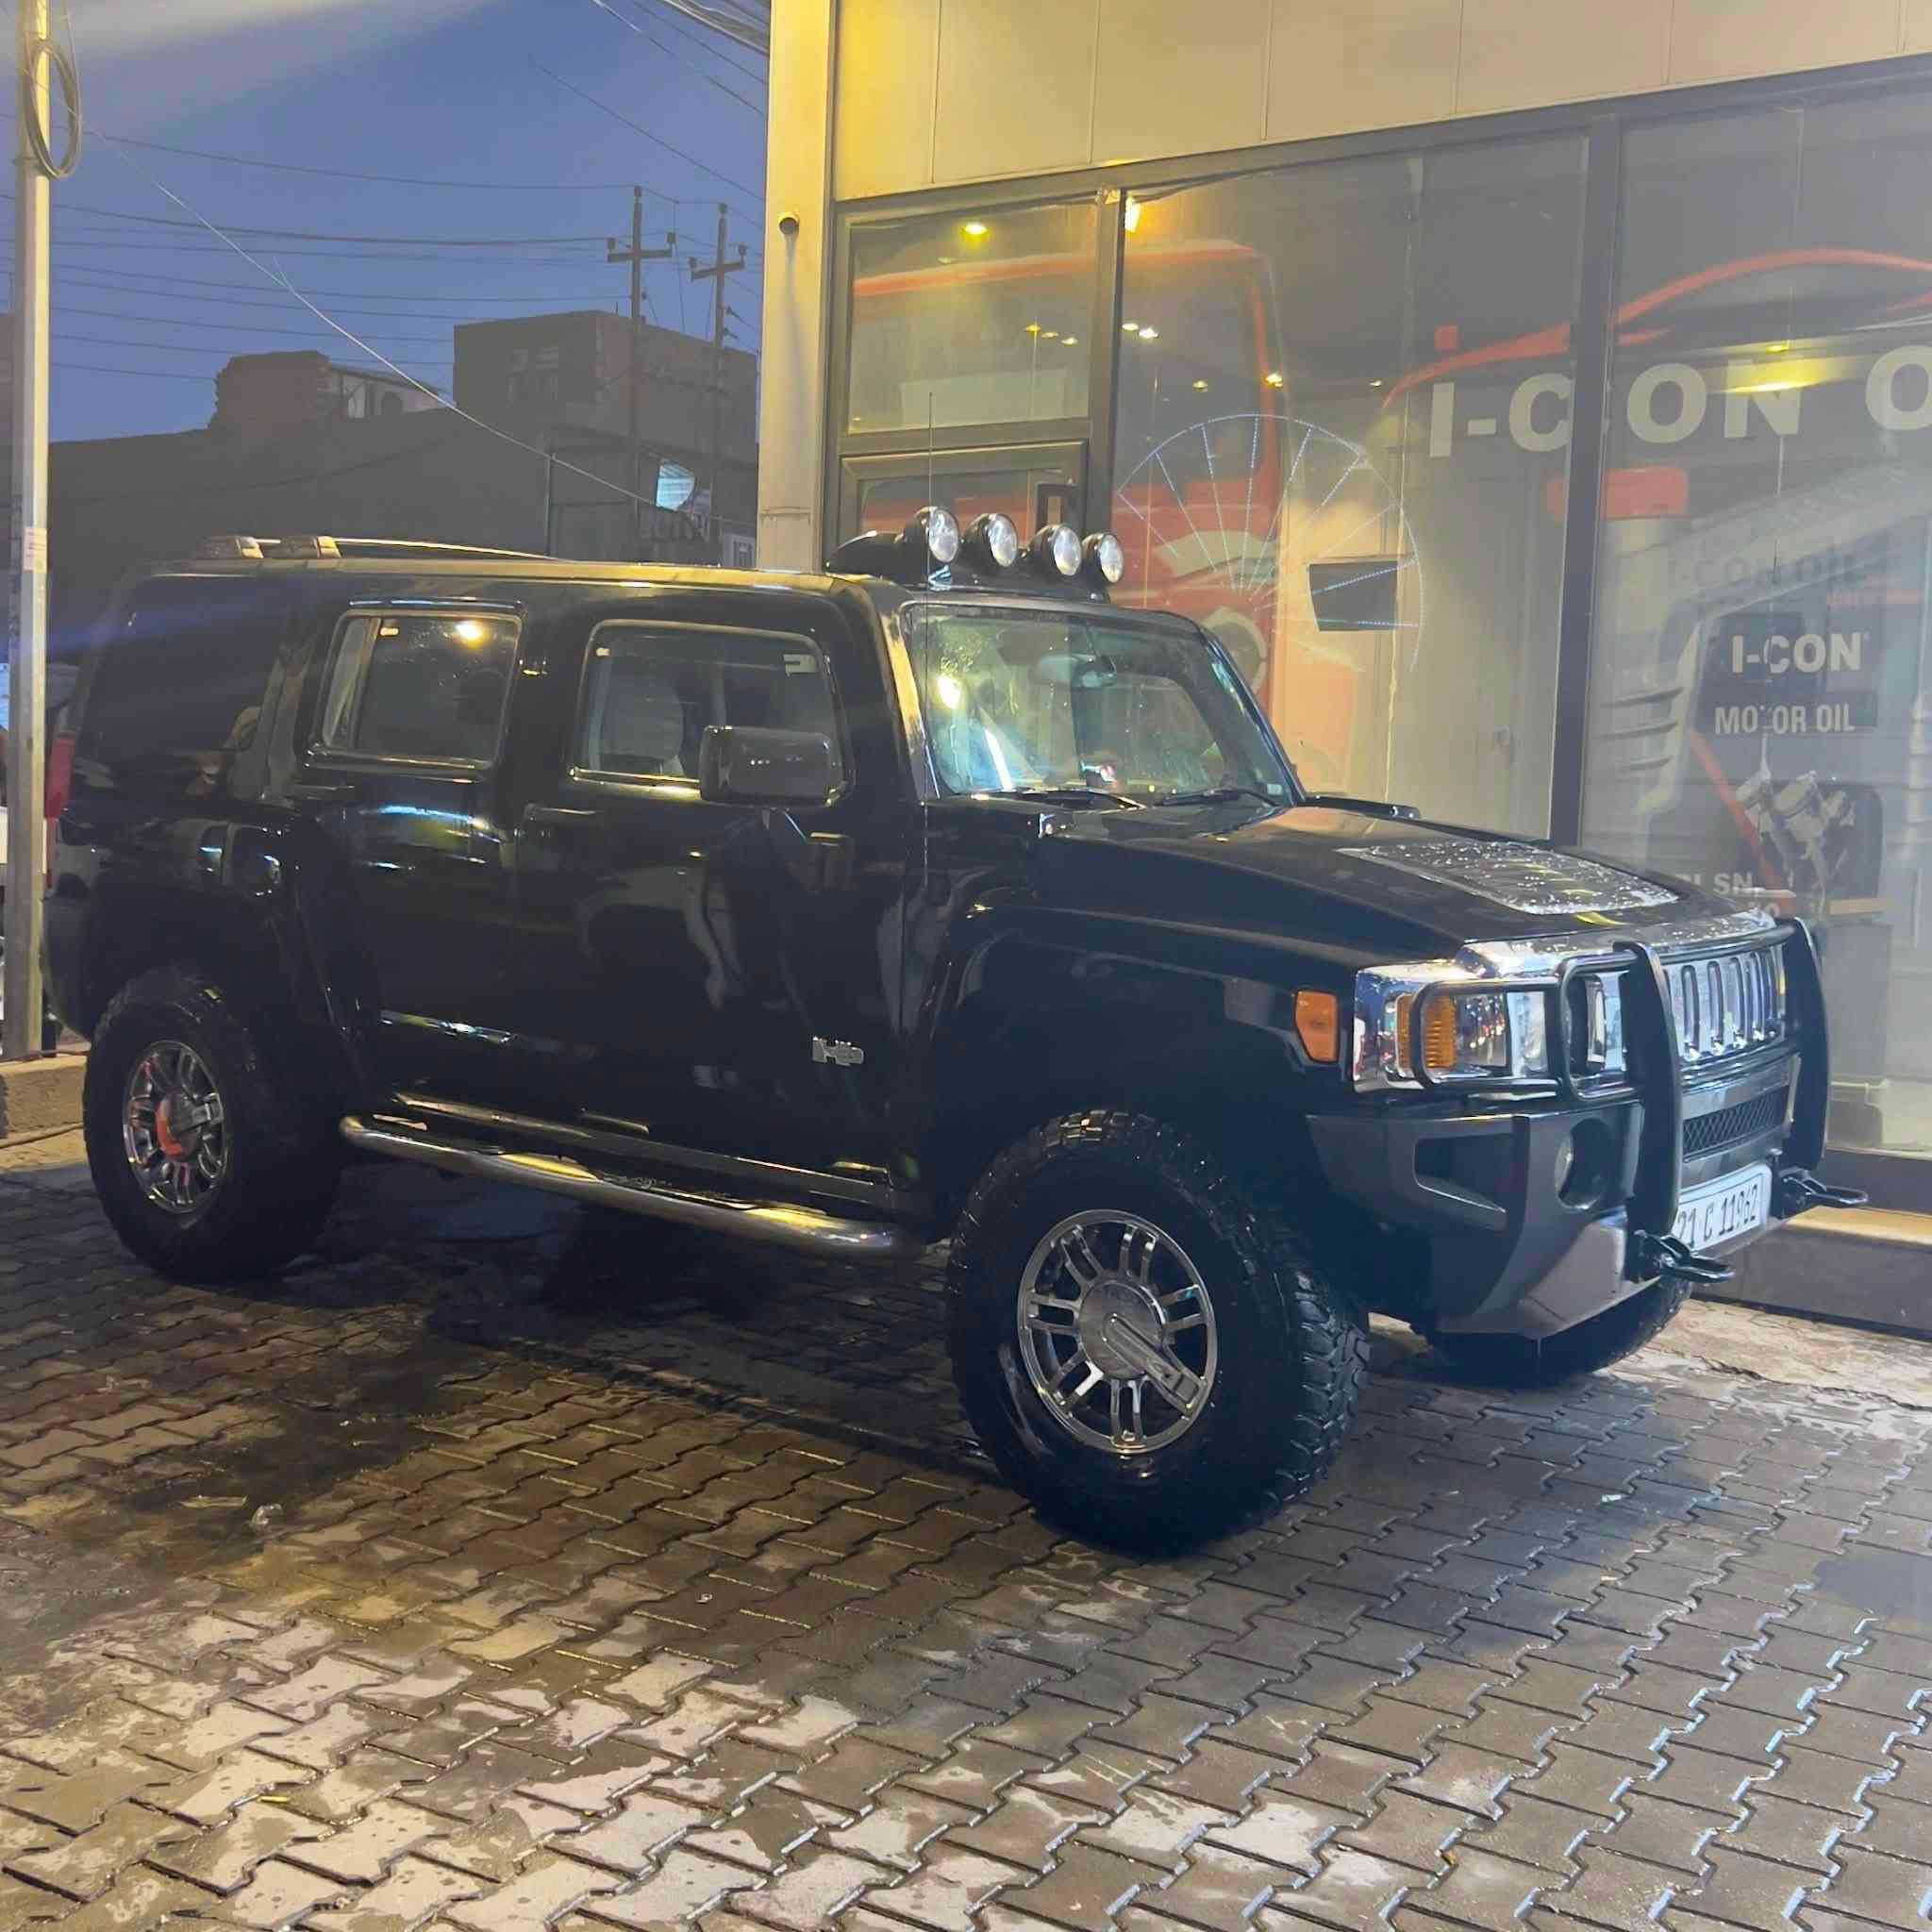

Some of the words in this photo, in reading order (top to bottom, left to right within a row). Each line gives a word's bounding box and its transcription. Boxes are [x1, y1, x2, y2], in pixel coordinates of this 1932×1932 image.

[1428, 358, 1804, 458] I-CON
[1731, 632, 1863, 674] I-CON
[1816, 704, 1856, 733] OIL
